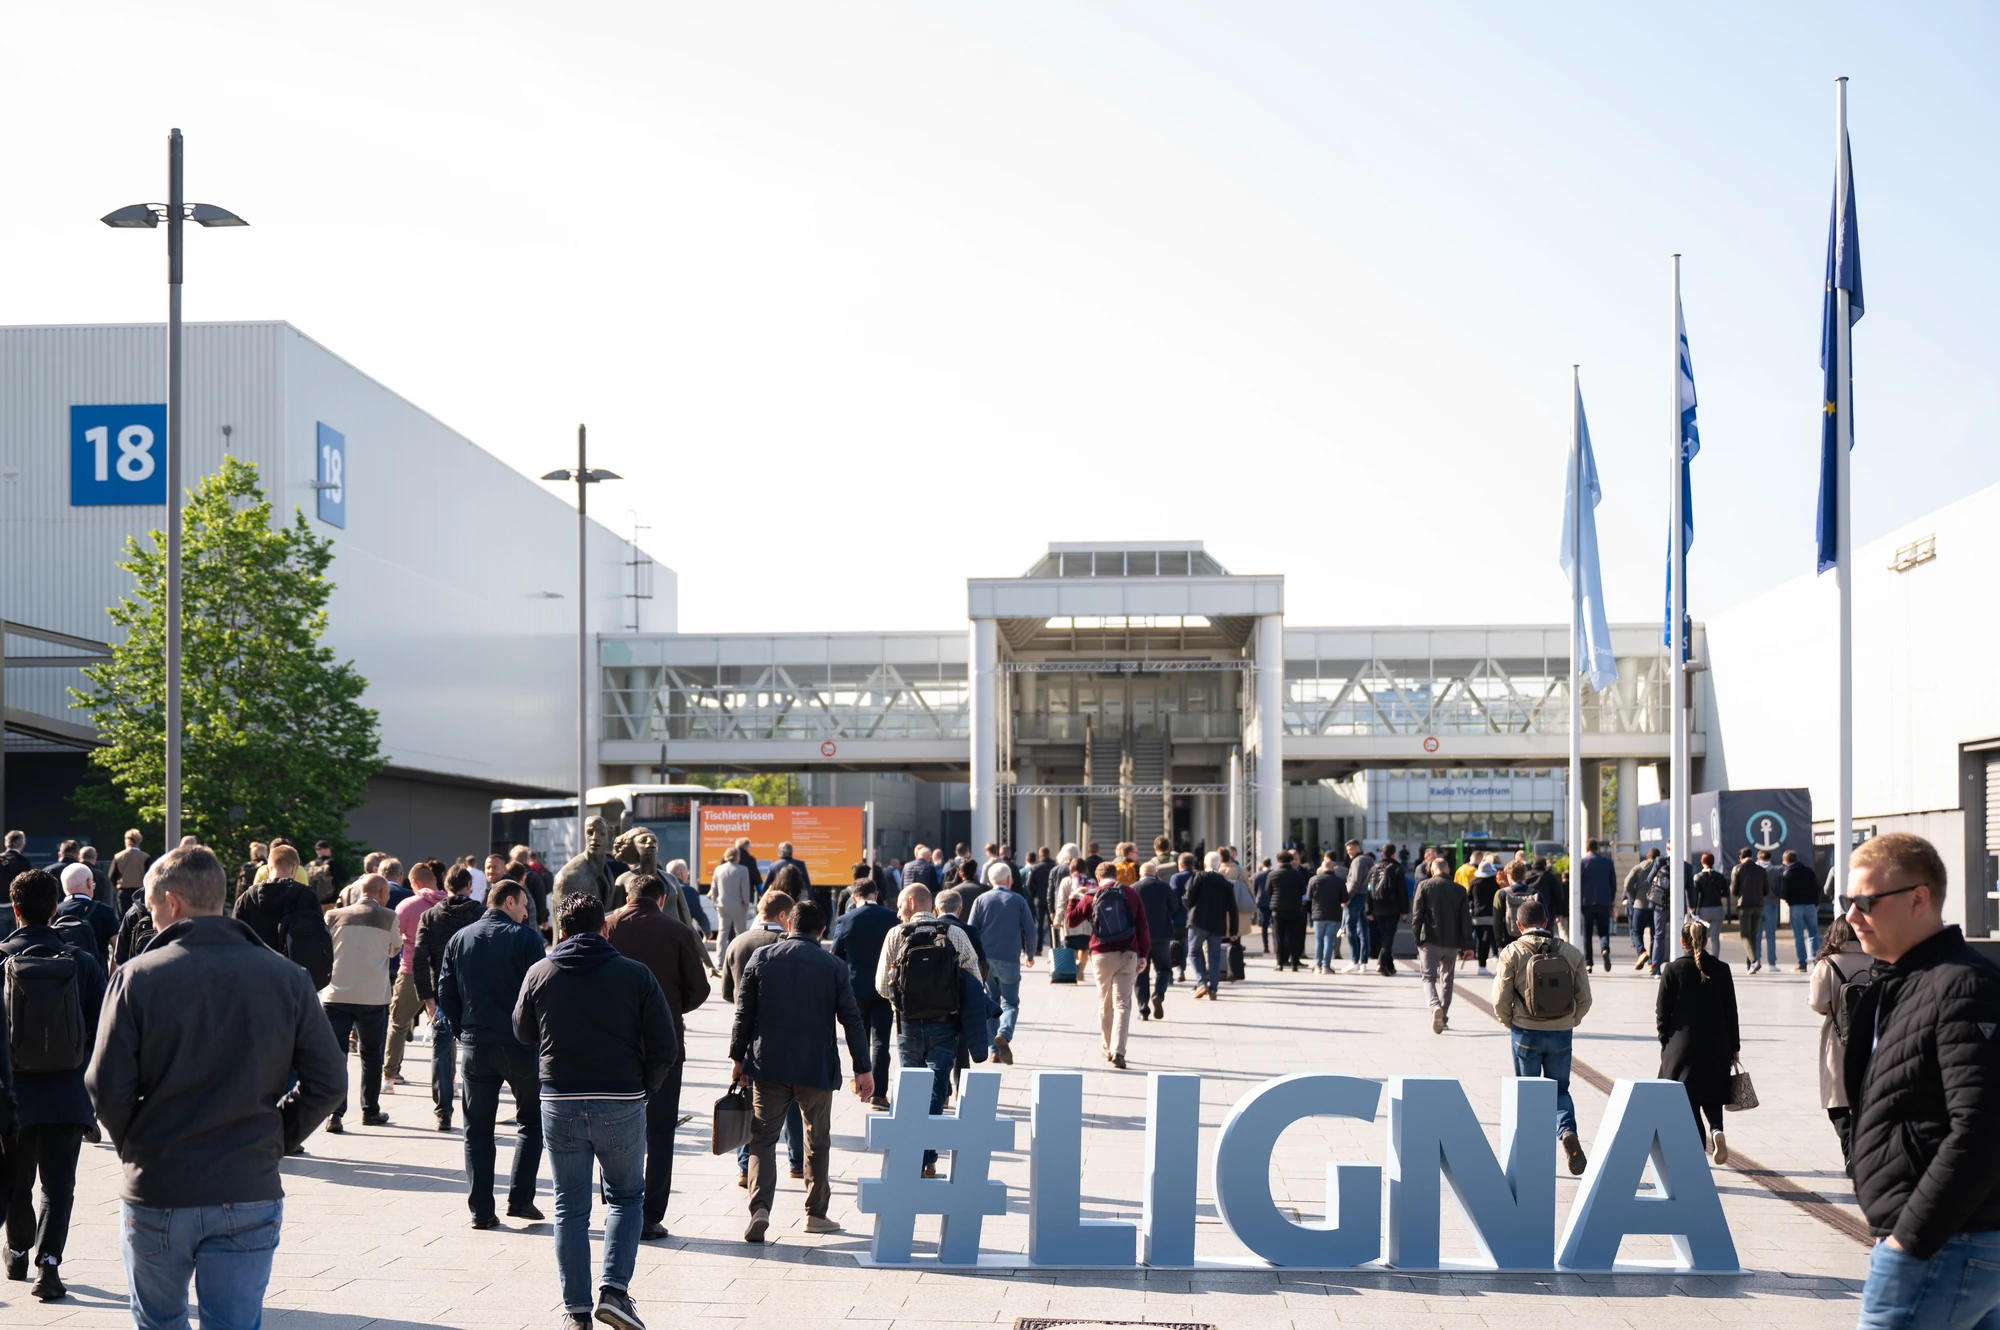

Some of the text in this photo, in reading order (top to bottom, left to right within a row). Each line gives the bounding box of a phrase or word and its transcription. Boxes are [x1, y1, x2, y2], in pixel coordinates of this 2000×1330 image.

[84, 424, 155, 482] 18
[323, 445, 342, 504] 18
[1430, 787, 1510, 796] Radio TV-Centrum
[704, 811, 774, 820] Tischlerwissen
[704, 822, 750, 833] kompakt!
[858, 1067, 1740, 1271] #LIGNA
